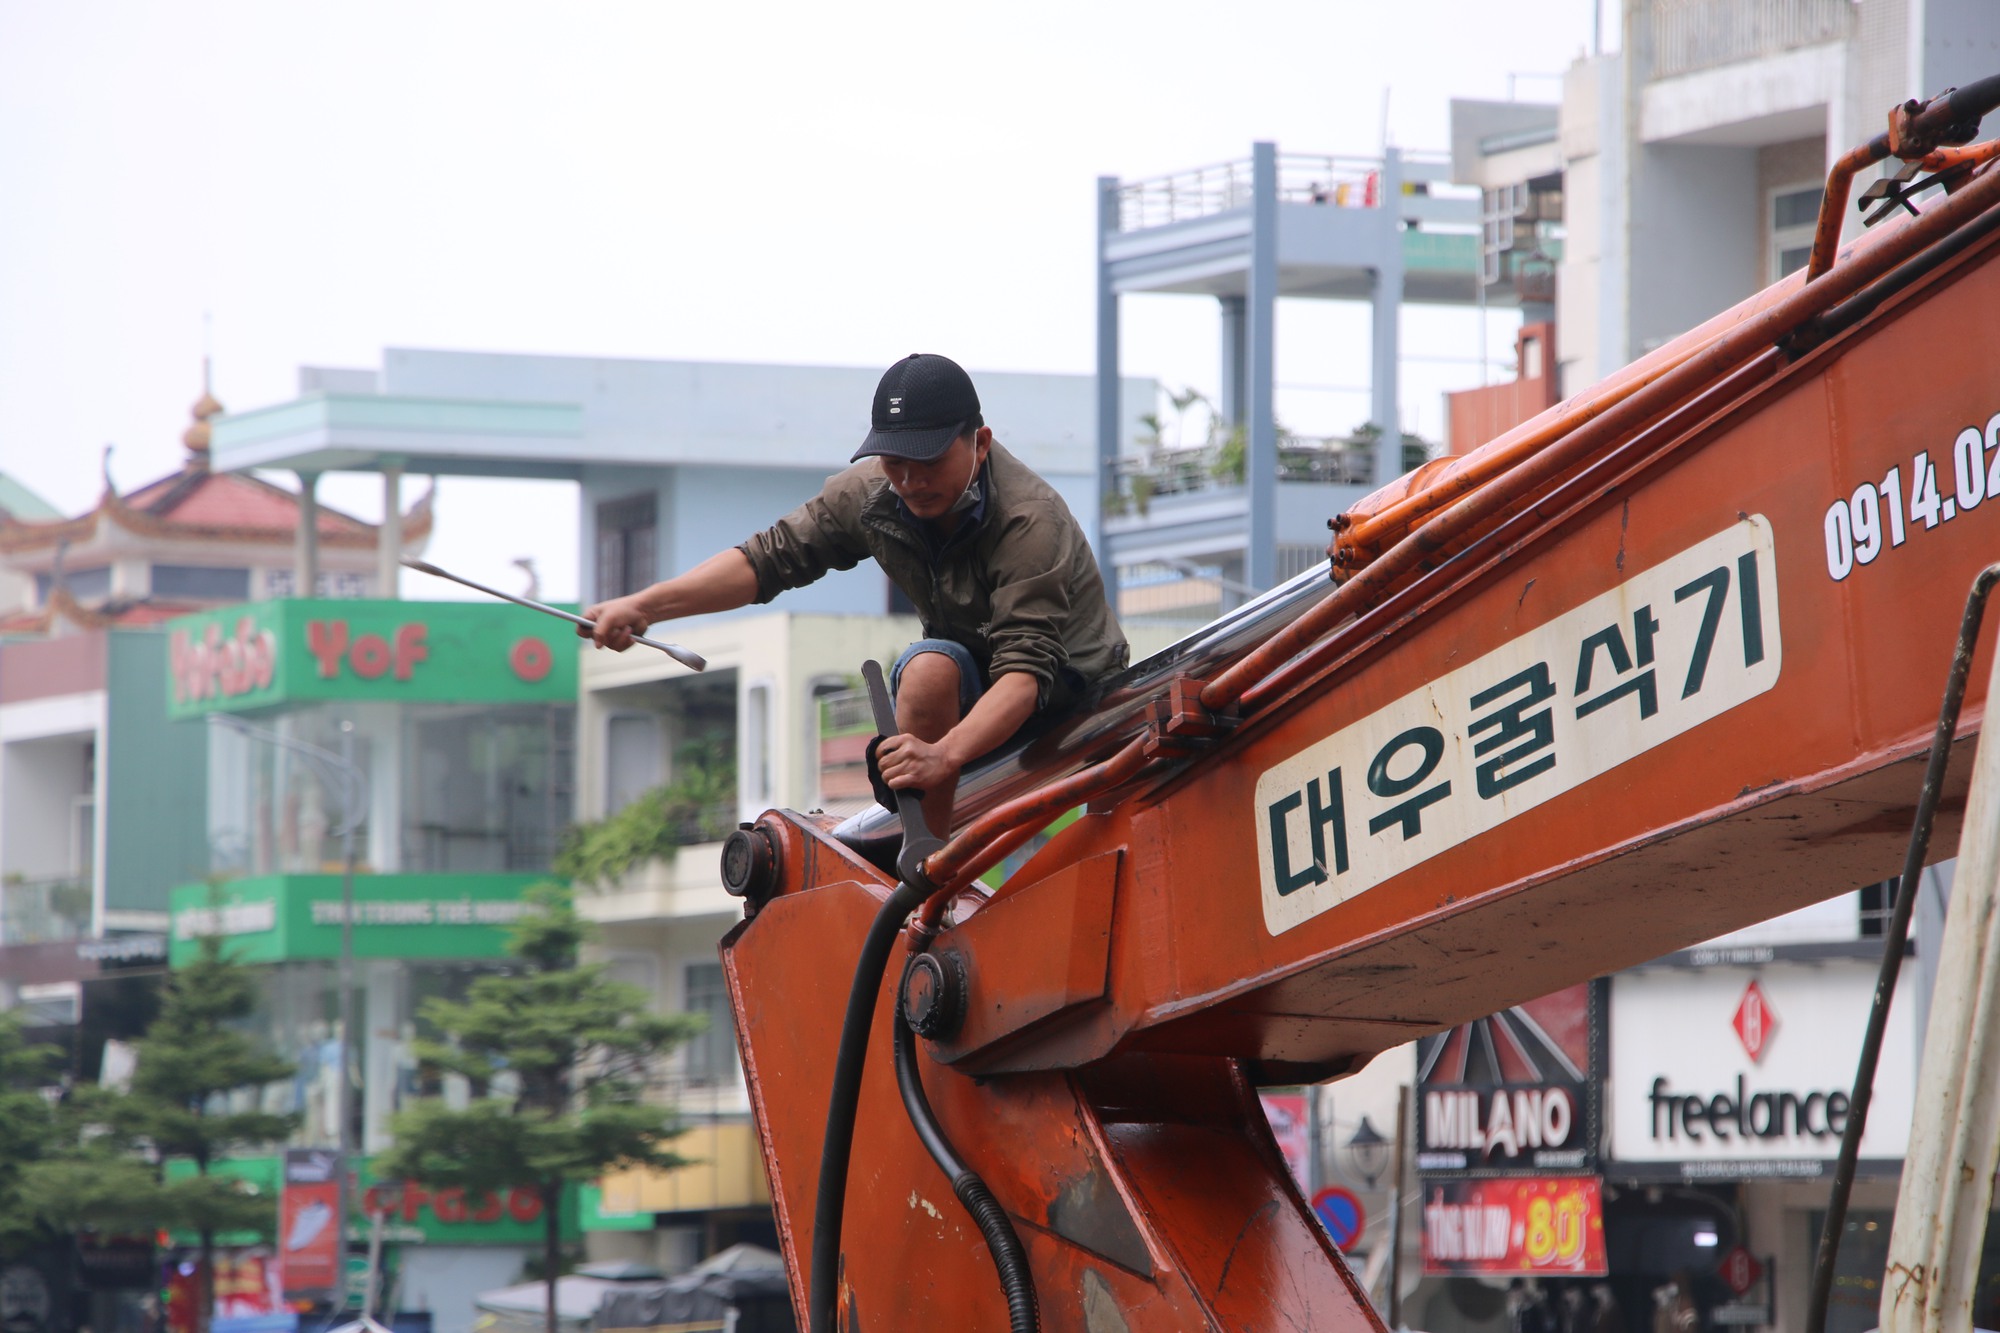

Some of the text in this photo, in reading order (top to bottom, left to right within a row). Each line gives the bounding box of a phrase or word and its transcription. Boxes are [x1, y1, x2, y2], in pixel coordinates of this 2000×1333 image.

[1268, 550, 1765, 898] 대우굴삭기
[1425, 1086, 1572, 1158] MILANO
[1648, 1073, 1850, 1140] freelance
